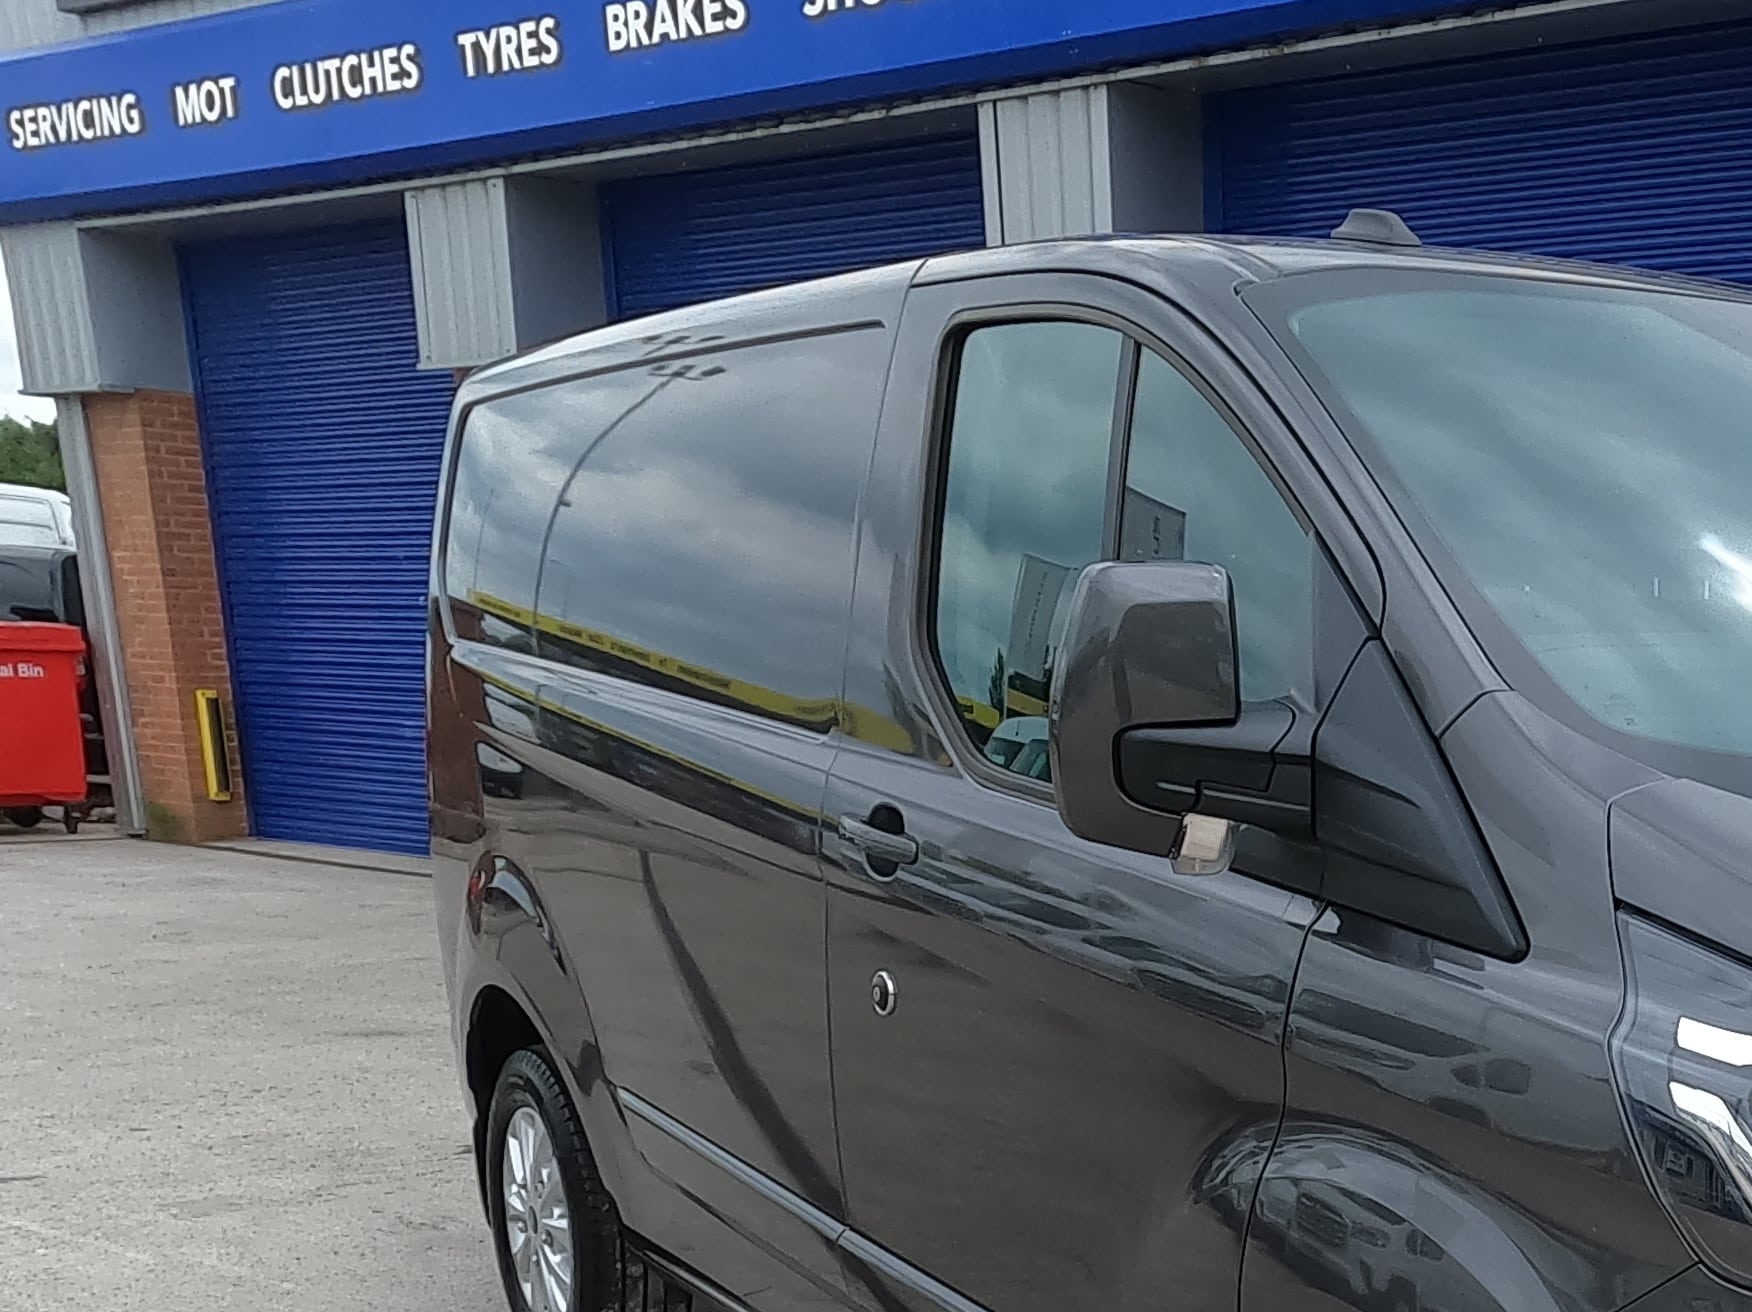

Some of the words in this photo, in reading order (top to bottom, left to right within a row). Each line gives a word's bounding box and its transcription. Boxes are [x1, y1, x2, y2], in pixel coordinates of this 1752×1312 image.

[9, 93, 142, 149] SERVICING
[174, 78, 236, 127] MOT
[273, 44, 420, 109] CLUTCHES
[456, 17, 559, 78] TYRES
[605, 0, 747, 52] BRAKES
[17, 662, 44, 678] Bin
